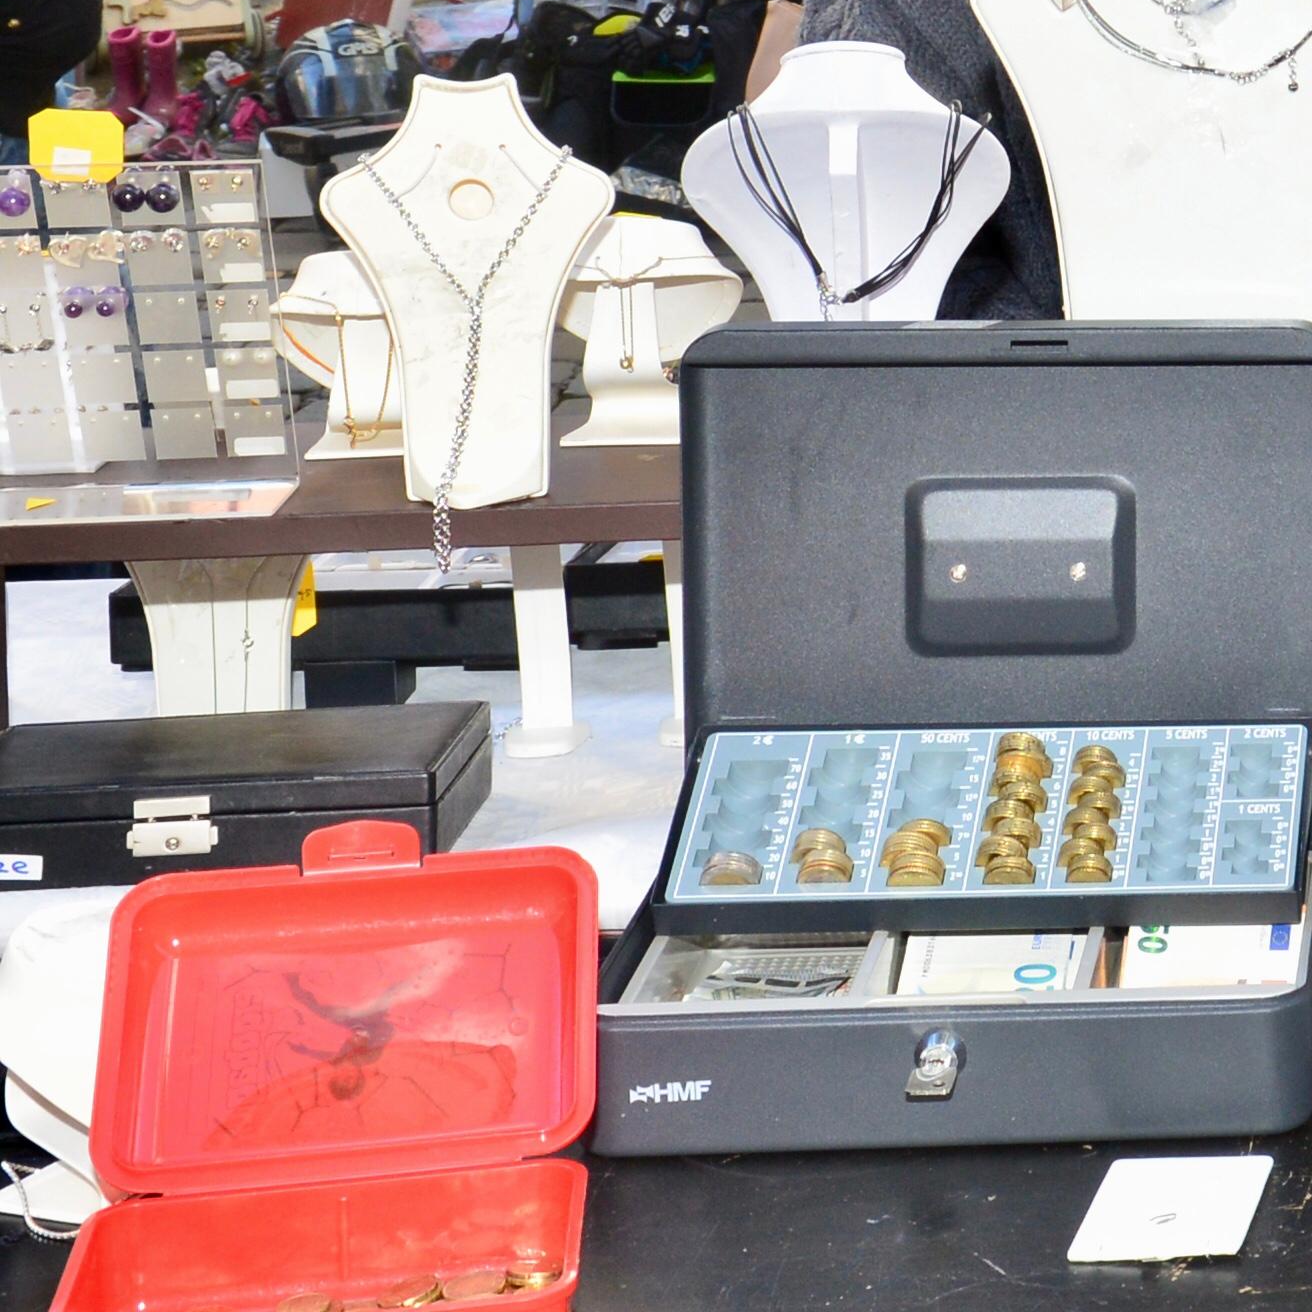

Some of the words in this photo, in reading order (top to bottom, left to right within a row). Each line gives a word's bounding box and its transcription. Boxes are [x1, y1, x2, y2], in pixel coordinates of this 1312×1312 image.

[920, 733, 936, 744] 50
[937, 732, 971, 744] CENTS
[1086, 730, 1100, 741] 10
[1101, 730, 1135, 741] CENTS
[1174, 729, 1208, 739] CENTS
[1243, 728, 1252, 739] 2
[1253, 728, 1287, 738] CENTS
[1247, 803, 1281, 814] CENTS
[653, 1079, 713, 1104] HMF
